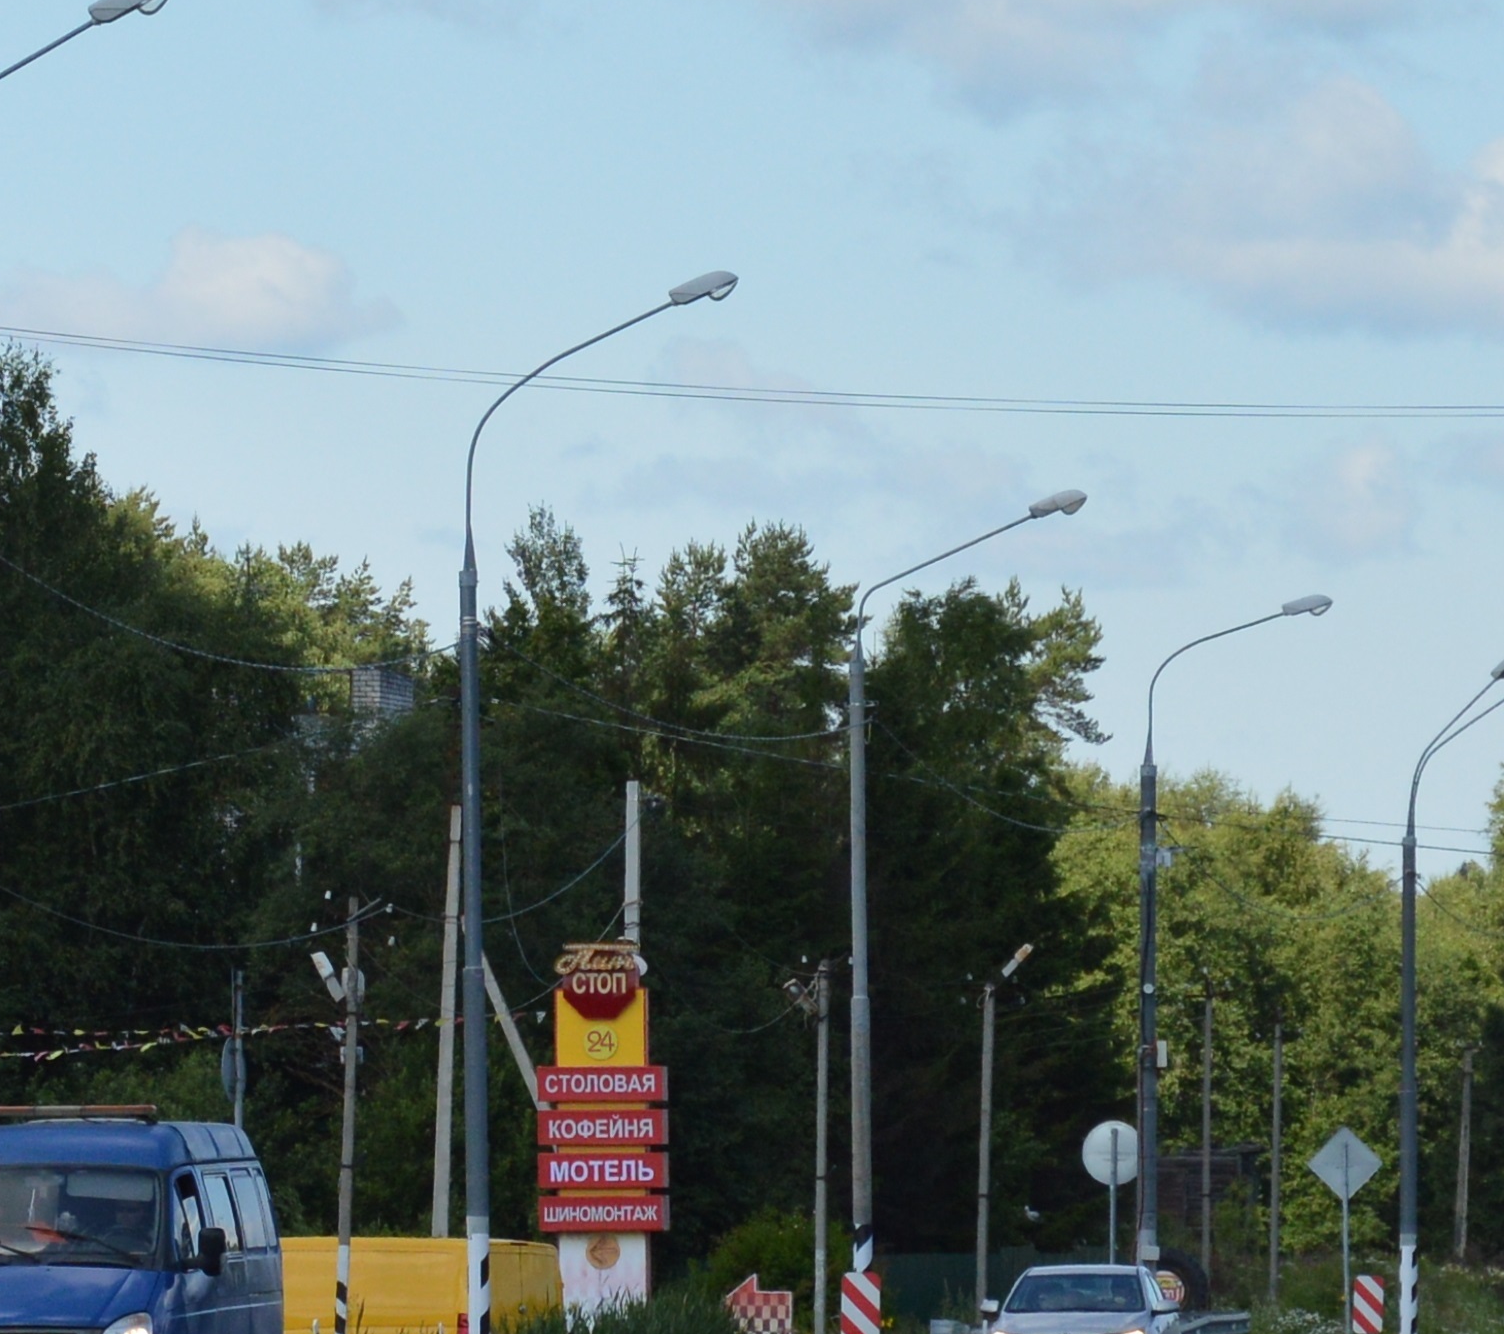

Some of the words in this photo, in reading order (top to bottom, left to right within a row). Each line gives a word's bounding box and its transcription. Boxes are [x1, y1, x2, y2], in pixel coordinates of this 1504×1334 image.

[572, 972, 627, 994] СТОП
[587, 1030, 615, 1052] 24
[545, 1074, 656, 1094] СТОЛОВАЯ
[548, 1114, 654, 1139] КОФЕЙНЯ
[550, 1159, 655, 1182] МОТЕЛЬ
[544, 1205, 658, 1223] ШИНОМОНТАЖ
